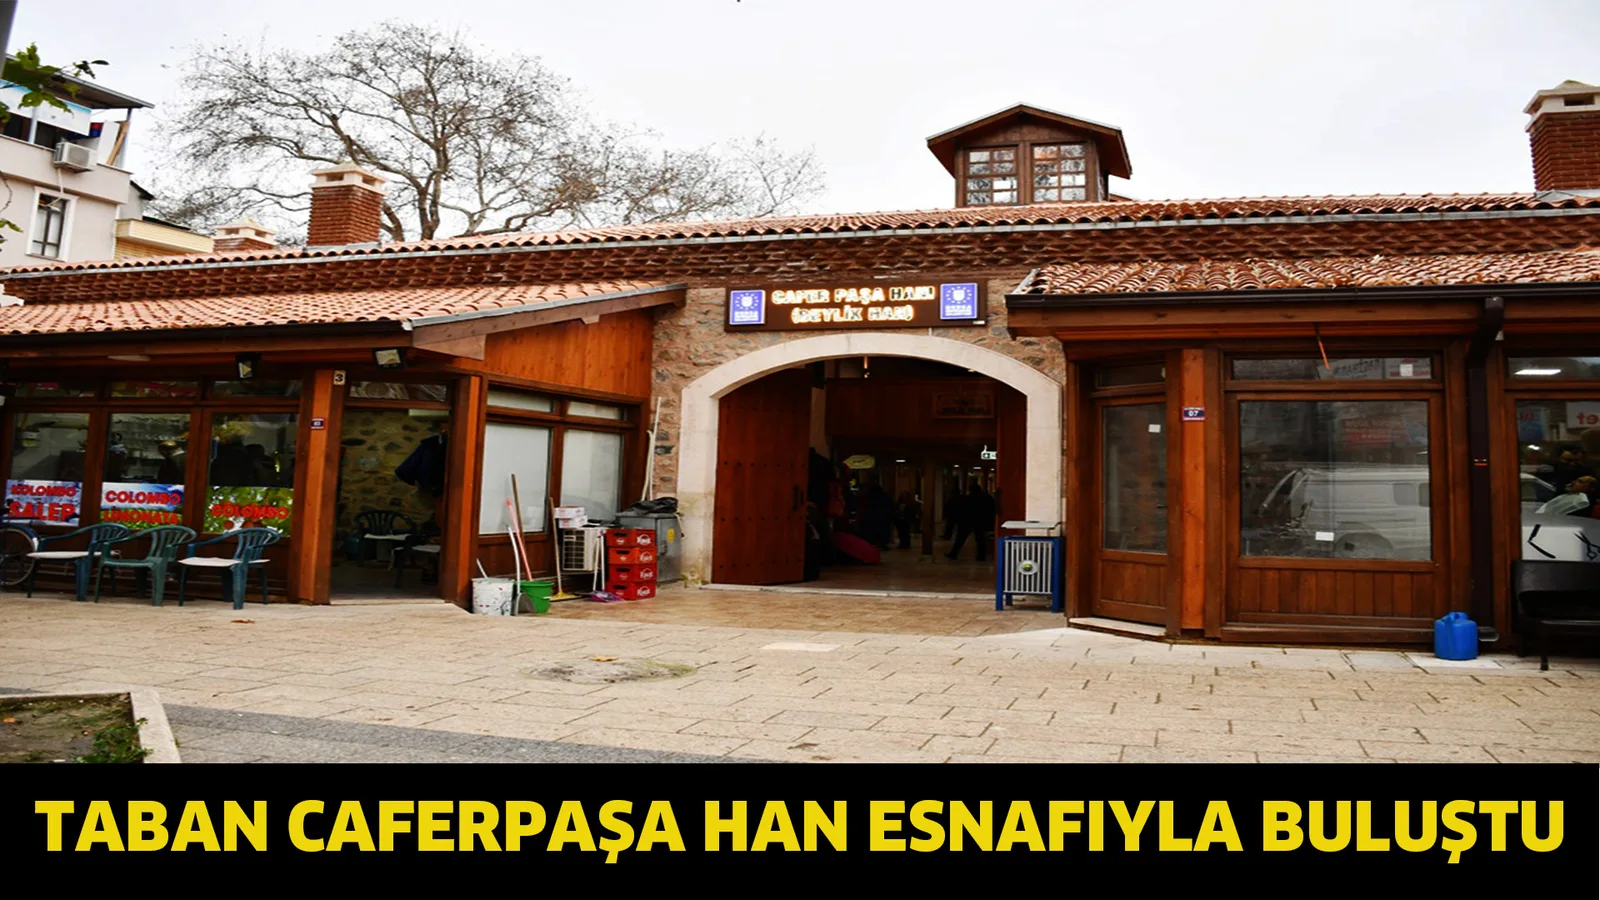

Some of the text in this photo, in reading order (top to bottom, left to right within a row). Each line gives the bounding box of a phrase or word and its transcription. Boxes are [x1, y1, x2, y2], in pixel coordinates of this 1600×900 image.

[772, 289, 830, 304] CAFER
[834, 287, 885, 305] PAŞA
[335, 373, 343, 382] 3
[105, 490, 181, 505] COLOMBO
[9, 501, 76, 522] SALEP
